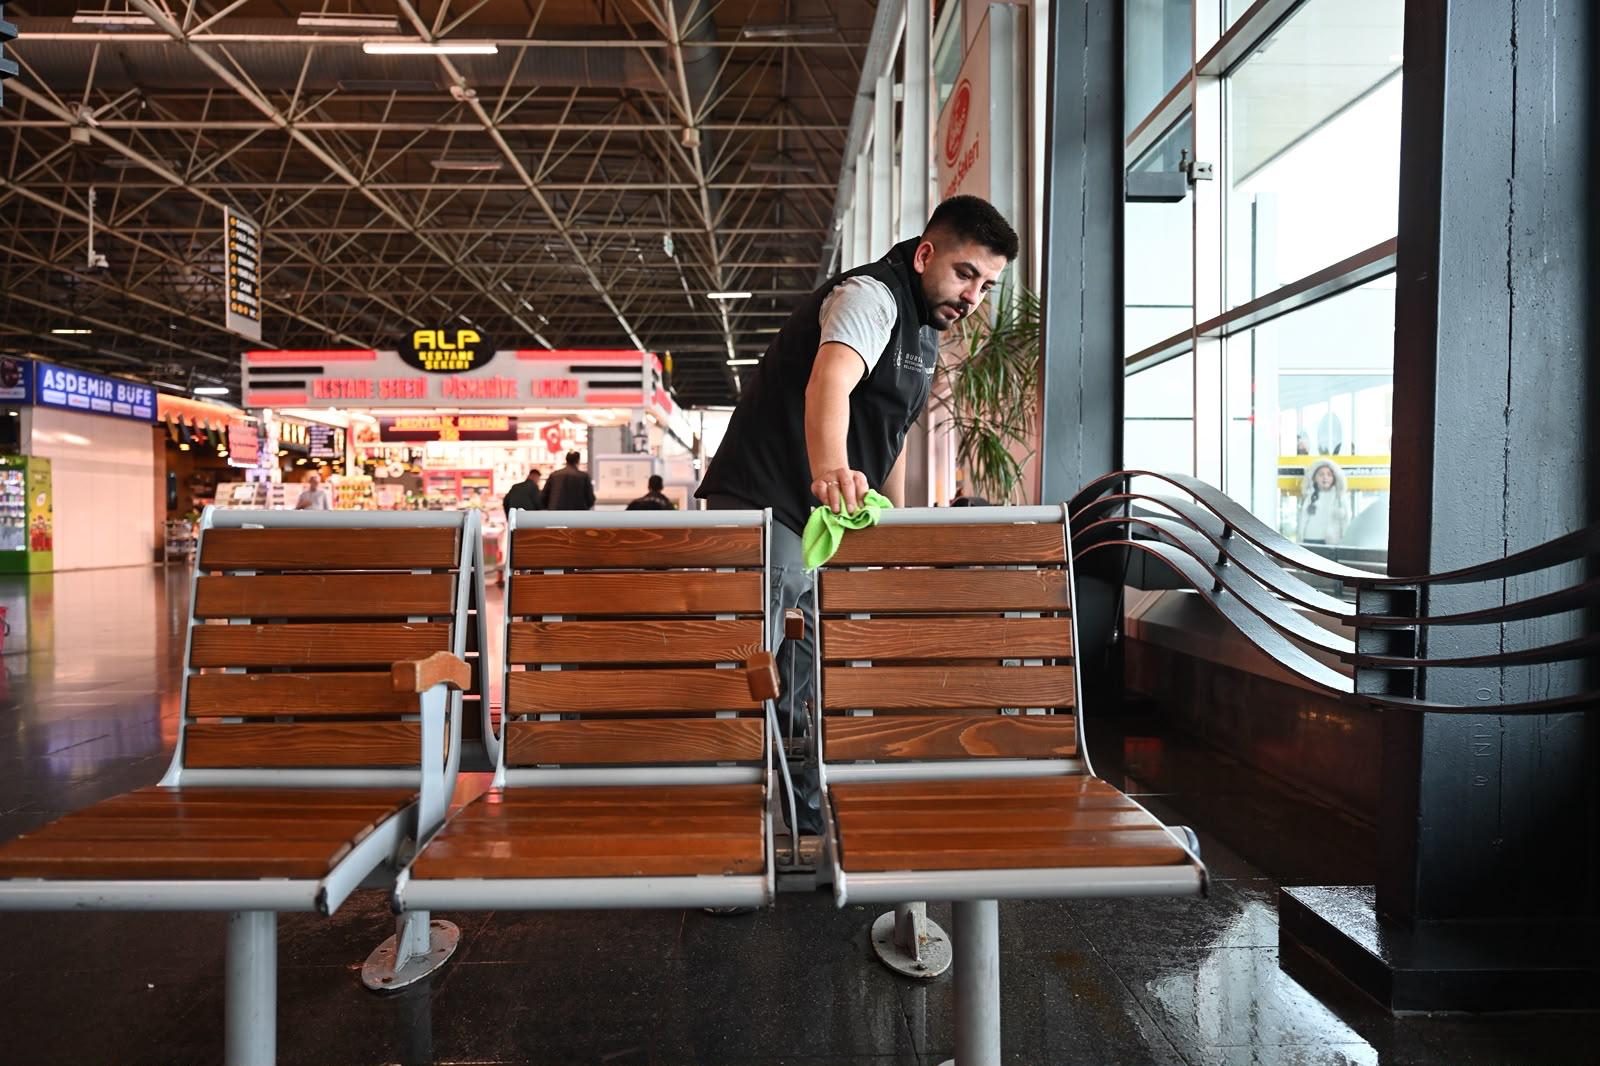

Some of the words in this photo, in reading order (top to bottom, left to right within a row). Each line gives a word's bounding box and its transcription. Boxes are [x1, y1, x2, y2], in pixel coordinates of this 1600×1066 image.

[413, 329, 481, 350] ALP
[419, 350, 474, 361] KESTANE
[43, 369, 113, 400] ASDEMİR
[117, 384, 152, 406] BÜFE
